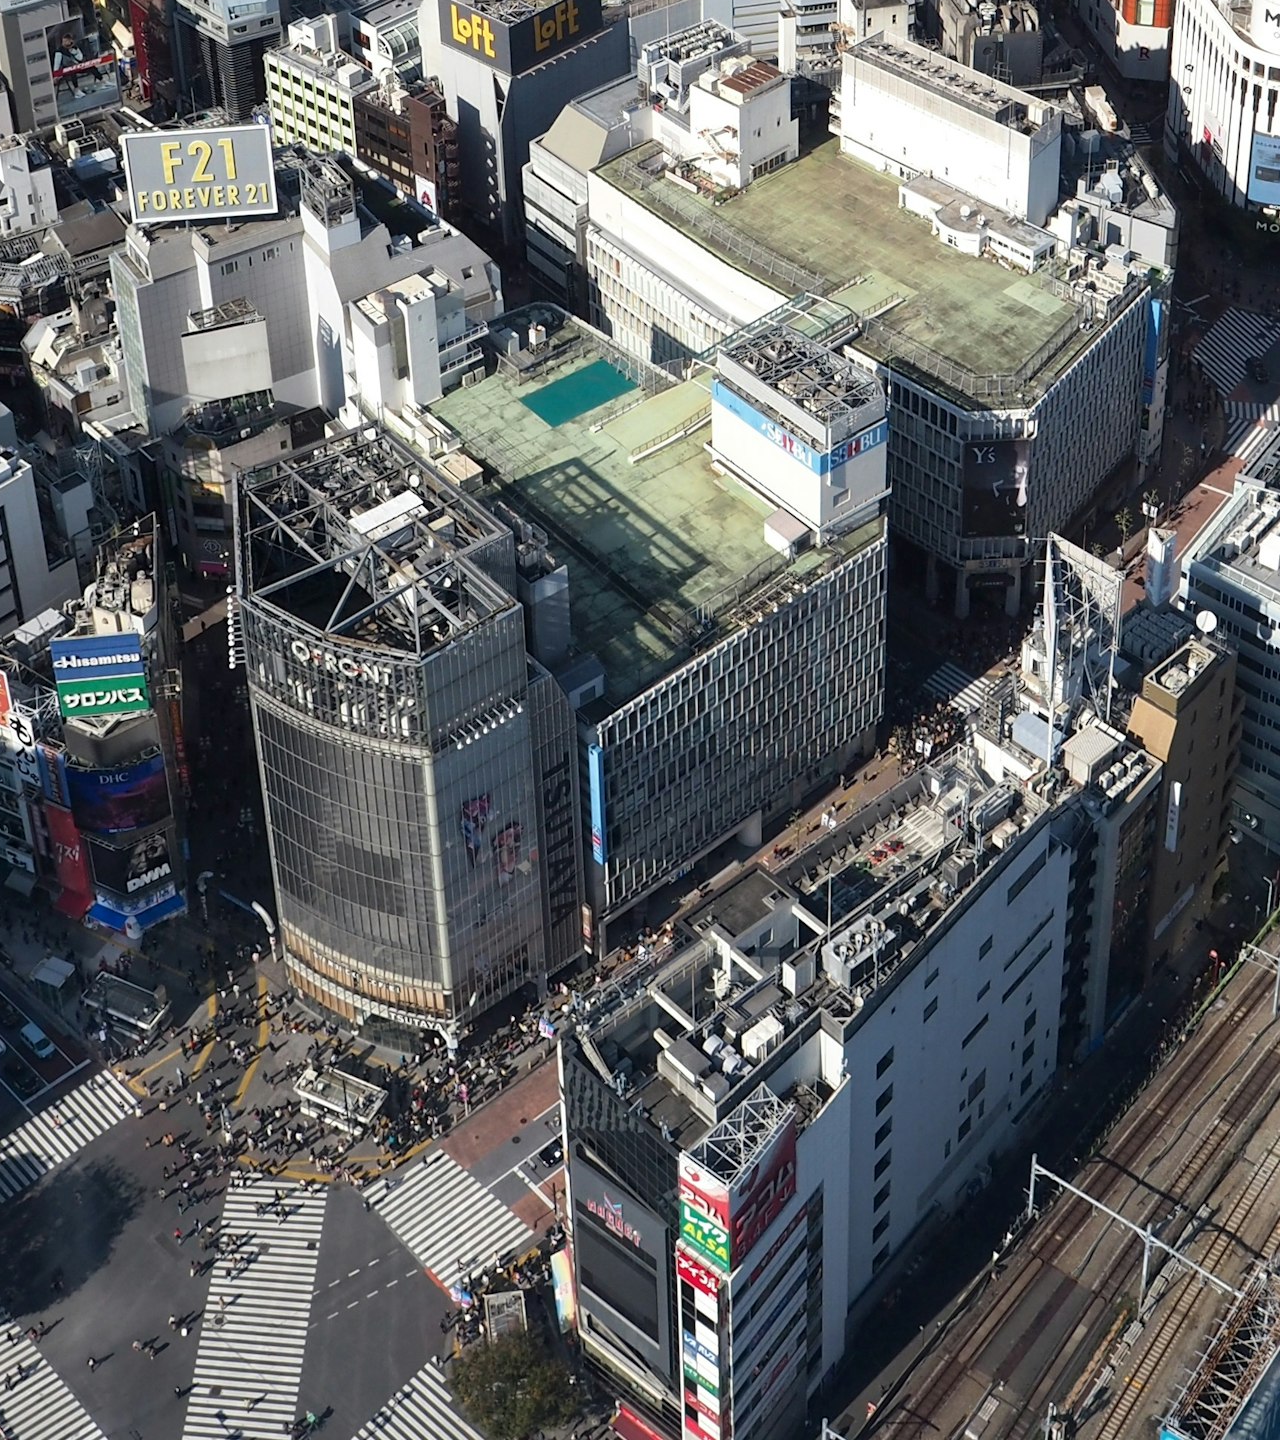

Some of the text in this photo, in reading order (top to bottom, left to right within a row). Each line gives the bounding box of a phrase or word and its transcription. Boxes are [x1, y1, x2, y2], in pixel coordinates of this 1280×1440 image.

[160, 137, 238, 185] F21
[137, 182, 270, 212] FOREVER 21
[763, 422, 814, 468] SEIBU
[830, 426, 881, 467] SEIBU
[53, 652, 140, 669] Hisamitsu
[63, 687, 144, 709] サロンパス
[99, 771, 129, 785] DHC
[543, 752, 577, 928] TSUTAYA
[126, 862, 172, 894] DMM
[389, 1011, 444, 1032] TSUTAYA
[680, 1184, 726, 1228] アコム
[683, 1204, 728, 1244] レイク
[683, 1222, 728, 1262] ALSA
[678, 1255, 719, 1293] アイフル
